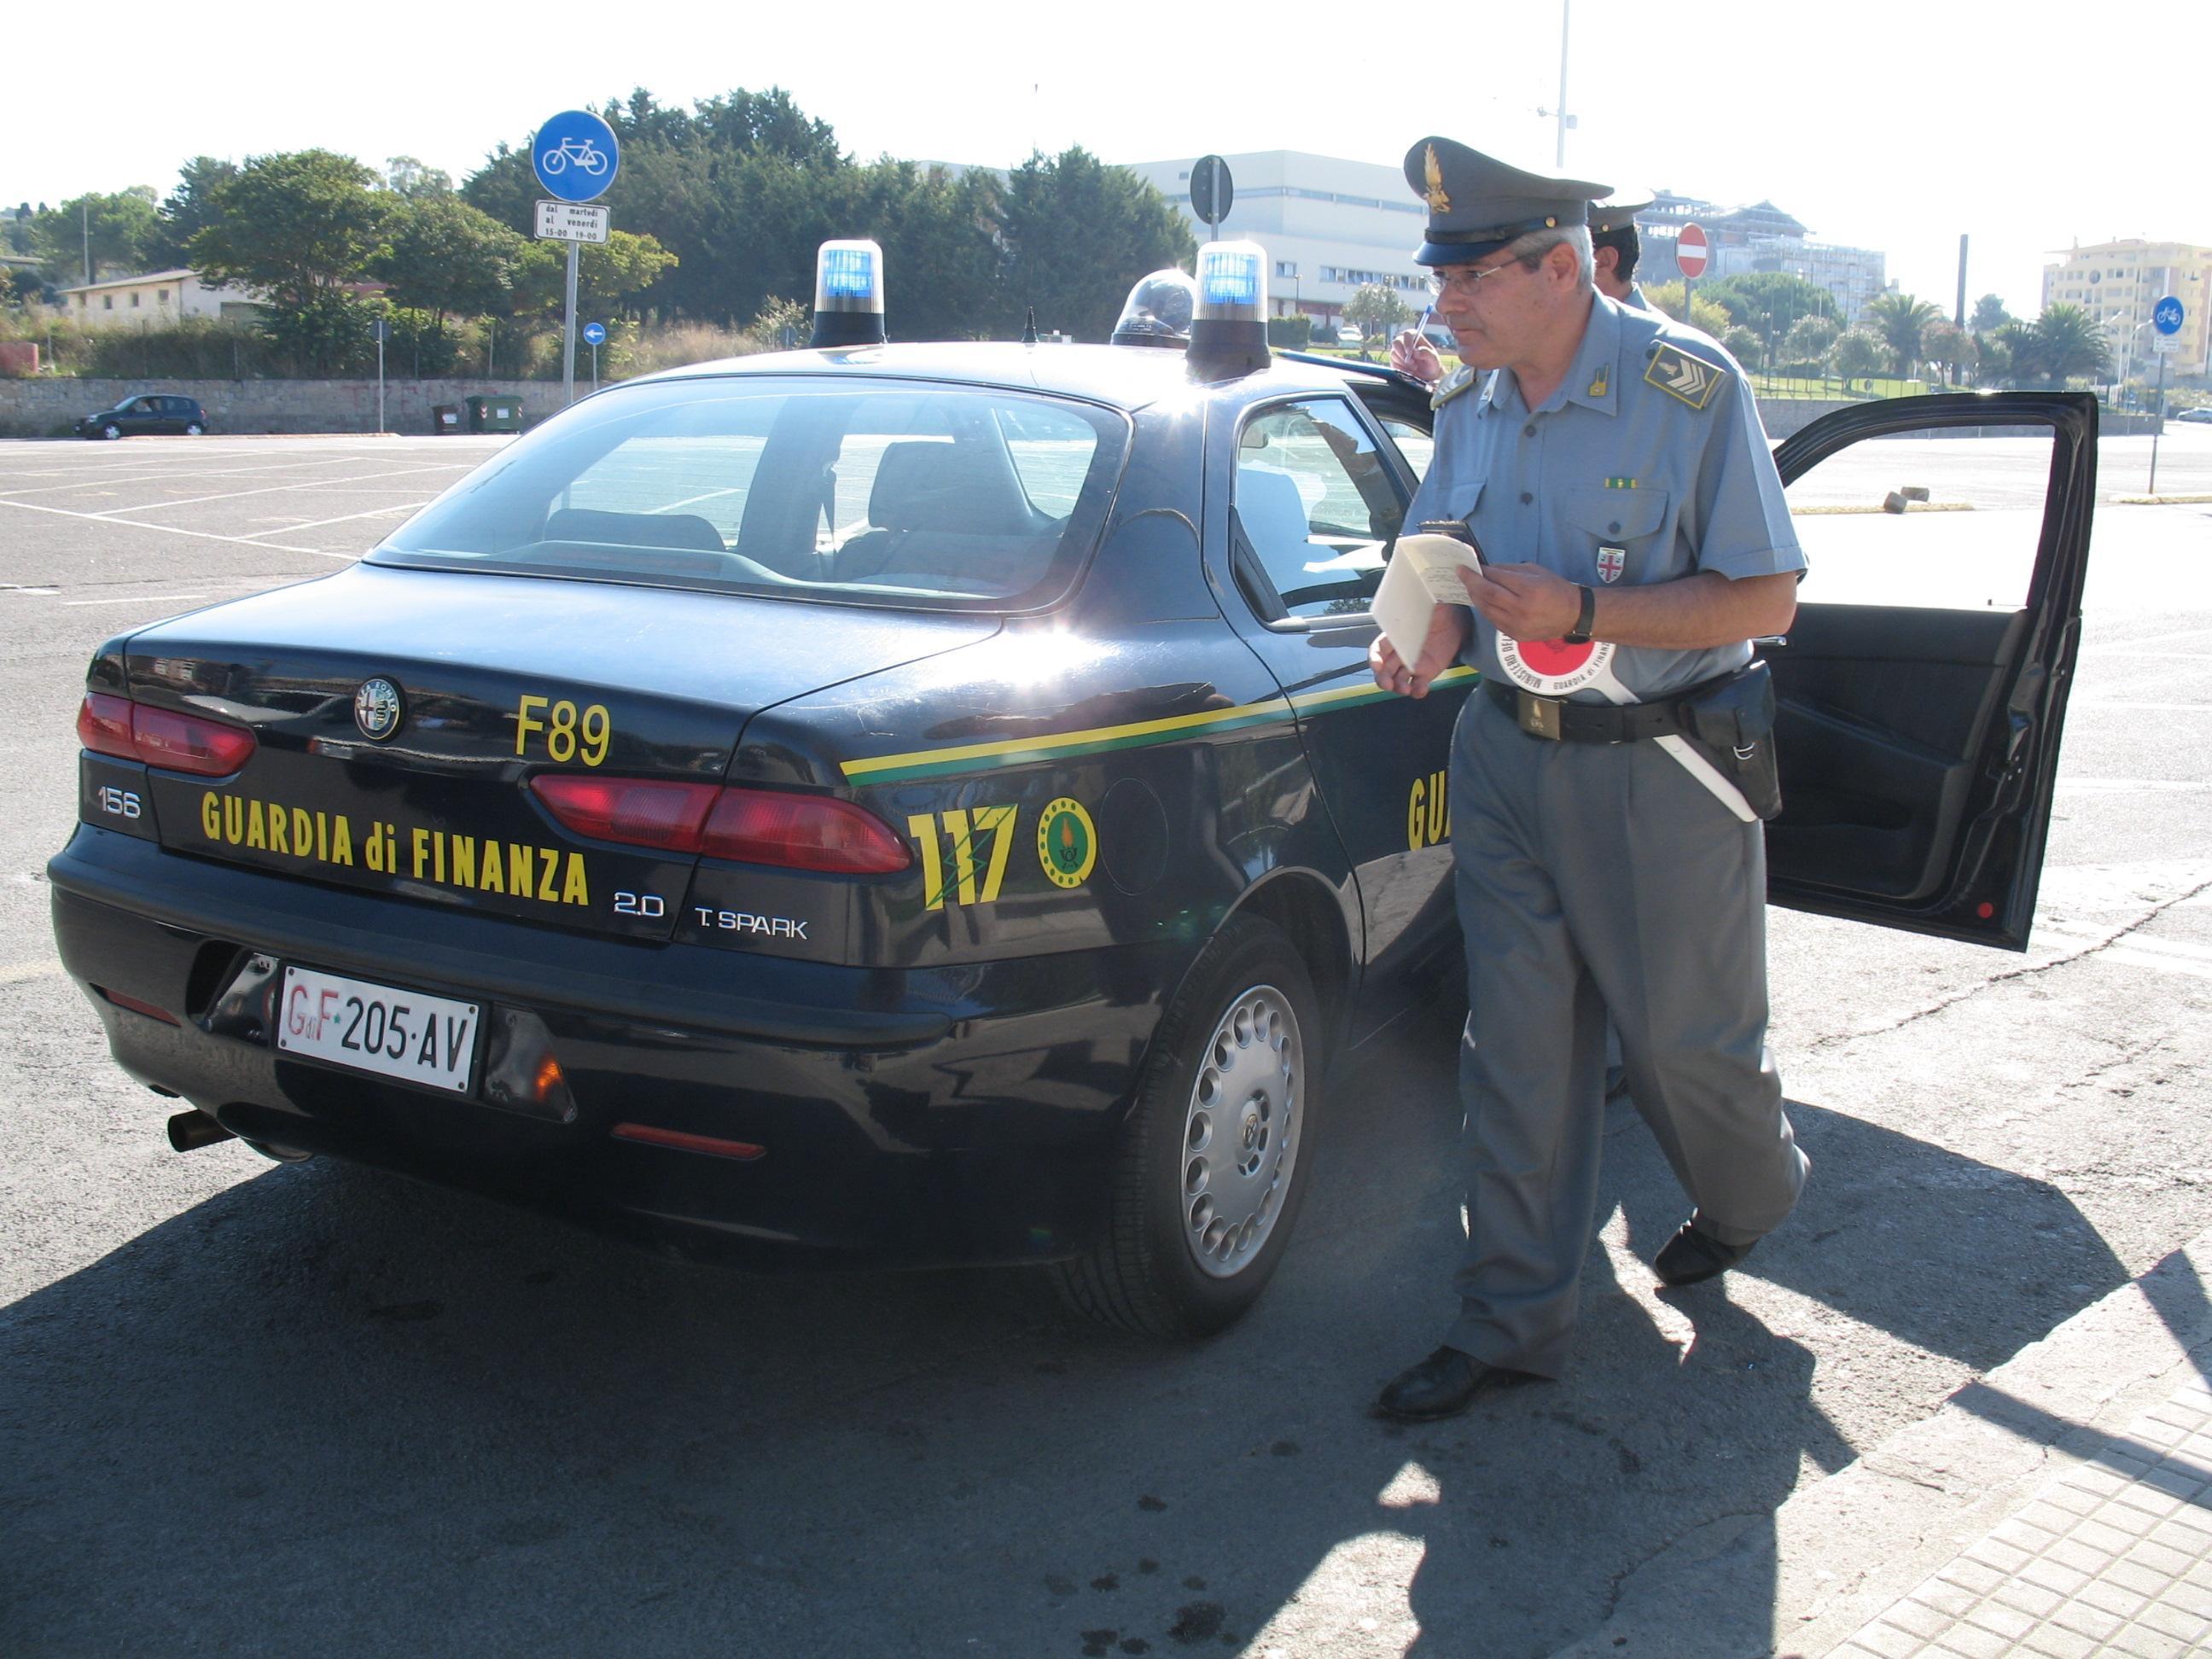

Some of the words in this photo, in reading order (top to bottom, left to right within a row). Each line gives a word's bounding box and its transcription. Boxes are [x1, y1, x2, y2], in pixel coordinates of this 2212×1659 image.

[545, 205, 558, 213] dal
[545, 215, 555, 224] al
[1596, 642, 1611, 667] FINANZ
[515, 695, 611, 766] F89
[97, 785, 142, 819] 156
[1408, 770, 1451, 852] GU
[201, 791, 354, 866] GUARDIA
[365, 821, 397, 874] di
[411, 827, 589, 905] FINANZA
[907, 803, 1019, 911] 117
[614, 891, 665, 917] 2.0
[719, 911, 810, 940] SPARK
